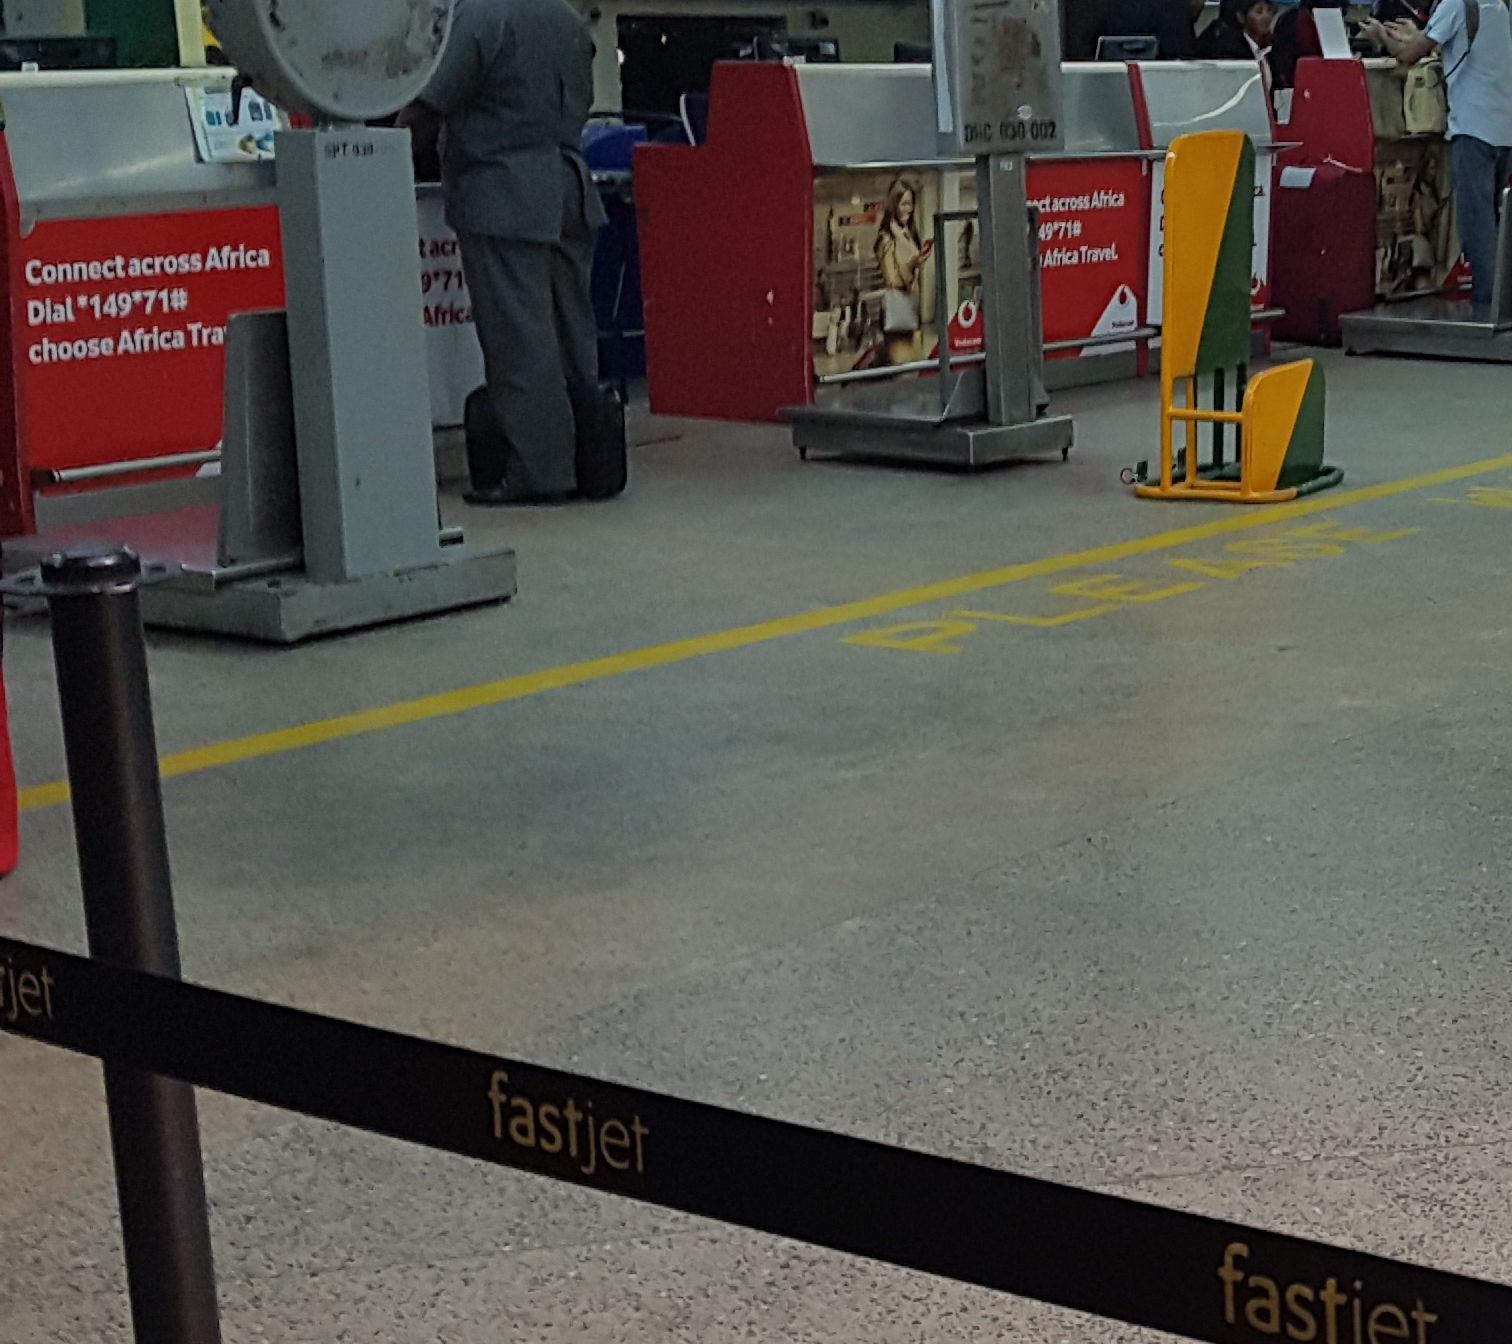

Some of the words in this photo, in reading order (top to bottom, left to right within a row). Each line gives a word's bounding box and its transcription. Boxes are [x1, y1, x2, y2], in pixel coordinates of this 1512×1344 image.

[1051, 194, 1090, 212] across
[1091, 188, 1125, 207] Africa
[1038, 221, 1082, 241] 4971#
[429, 240, 457, 258] acr
[1044, 246, 1079, 268] Africa
[25, 254, 126, 287] Connect
[127, 253, 203, 278] across
[204, 243, 271, 273] Africa
[27, 295, 76, 327] Dial
[28, 337, 114, 365] choose
[116, 325, 186, 356] Africa
[186, 322, 228, 347] Tra
[485, 1069, 651, 1177] fastjet
